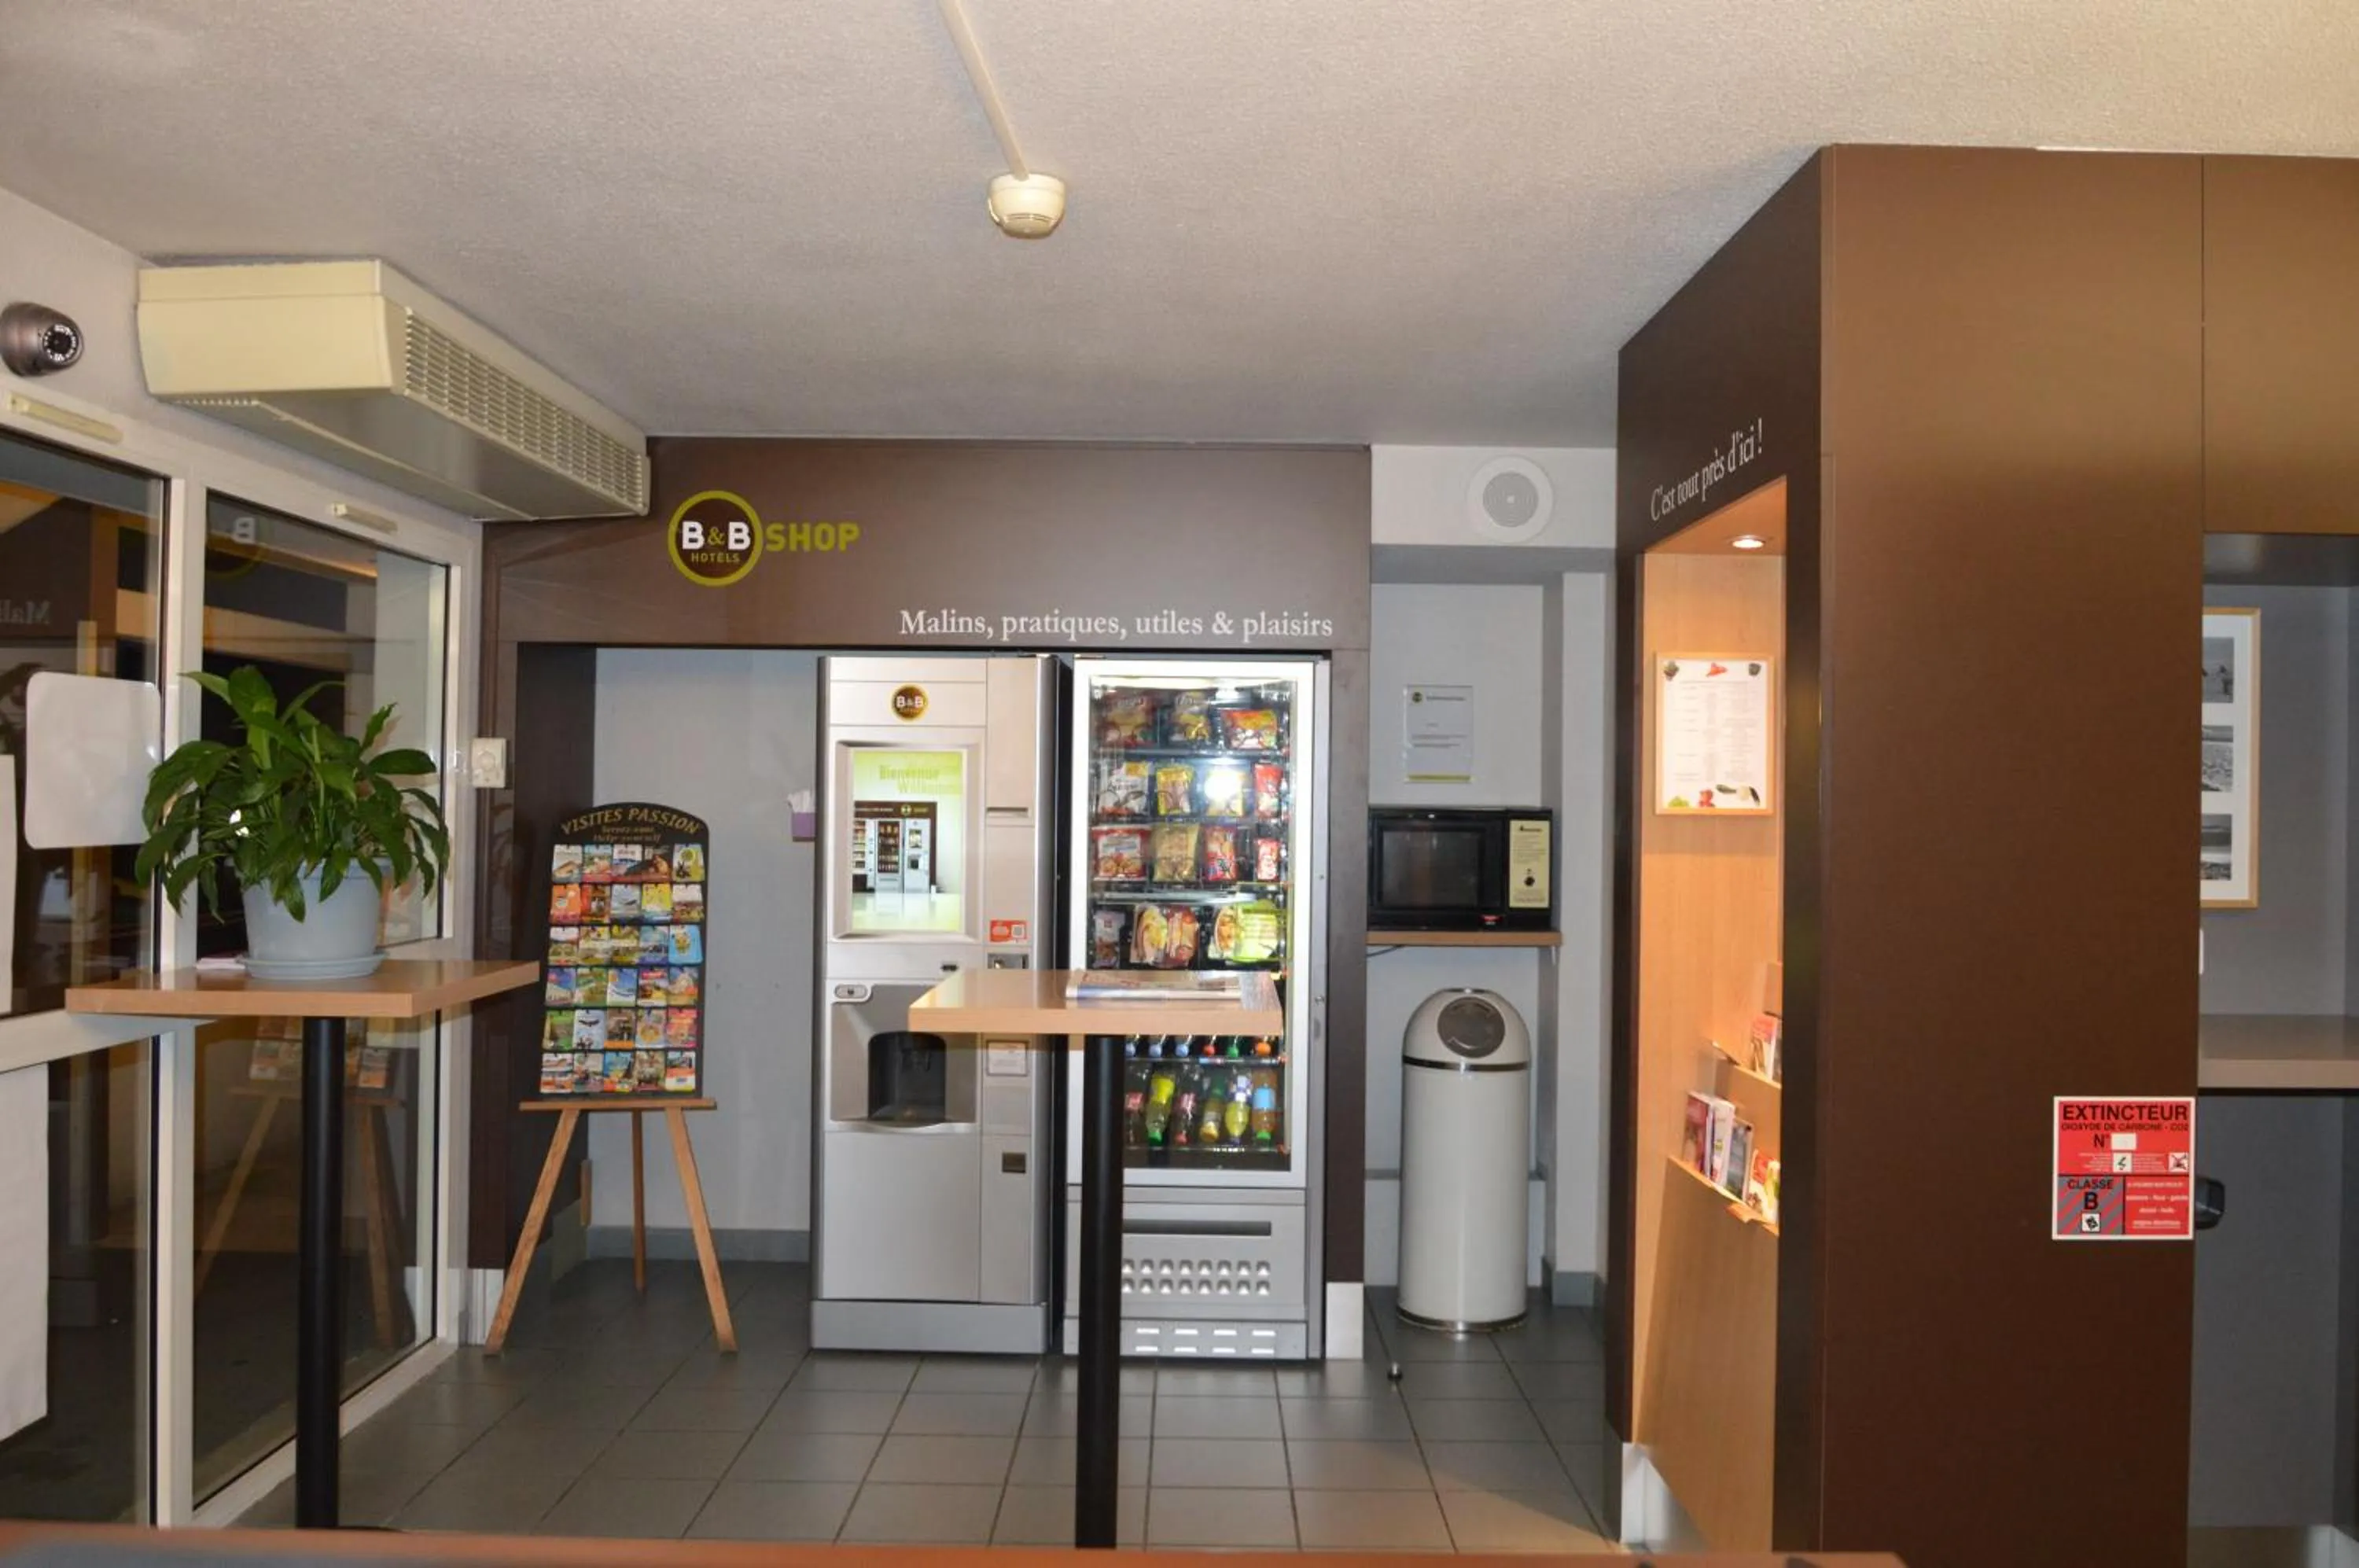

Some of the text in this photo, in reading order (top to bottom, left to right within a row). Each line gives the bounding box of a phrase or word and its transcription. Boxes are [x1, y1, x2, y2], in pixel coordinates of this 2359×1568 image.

[1651, 484, 1676, 521] C'est
[1677, 472, 1699, 505] tout
[1702, 447, 1725, 502] près
[765, 521, 861, 552] SHOP
[691, 552, 741, 563] HOTELS
[900, 608, 1333, 644] Malins, pratiques, utiles & plaisirs
[561, 808, 701, 836] VISITES PASSION
[2063, 1105, 2188, 1121] EXTINCTEUR
[2103, 1122, 2115, 1131] DE
[2067, 1180, 2114, 1189] CLASSE
[2085, 1191, 2099, 1210] B
